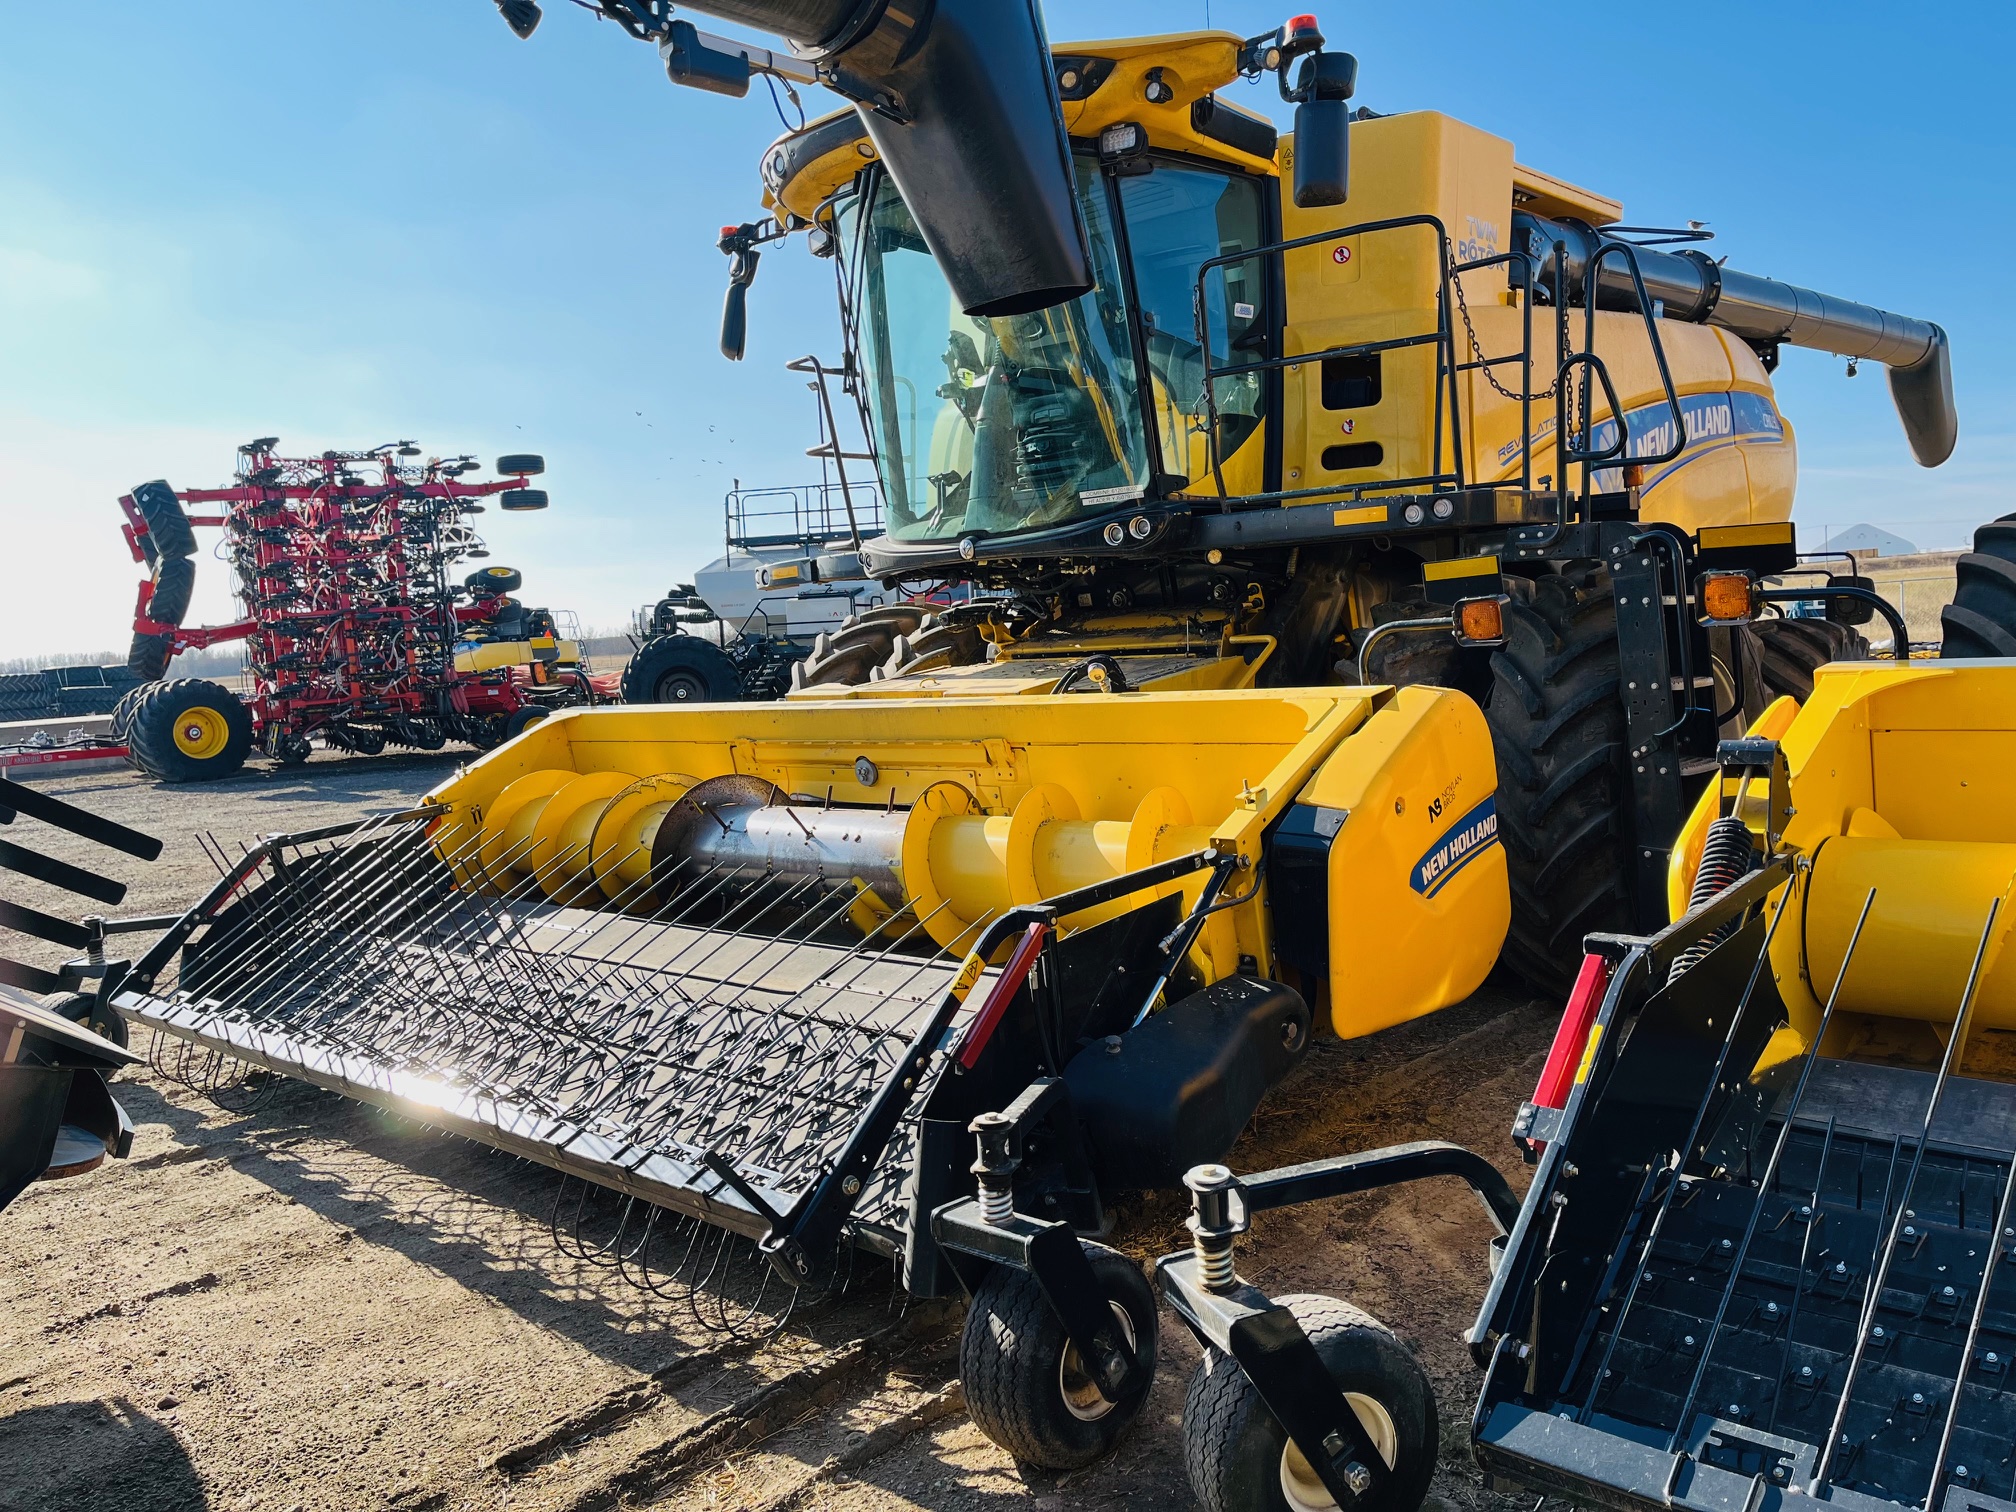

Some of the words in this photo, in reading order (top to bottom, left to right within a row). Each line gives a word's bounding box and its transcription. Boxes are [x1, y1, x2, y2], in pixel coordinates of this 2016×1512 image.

[1466, 215, 1498, 243] TWIN
[1459, 239, 1505, 271] ROTOR
[1636, 420, 1669, 459] NEW
[1421, 846, 1449, 886] NEW
[1449, 813, 1498, 860] HOLLAND
